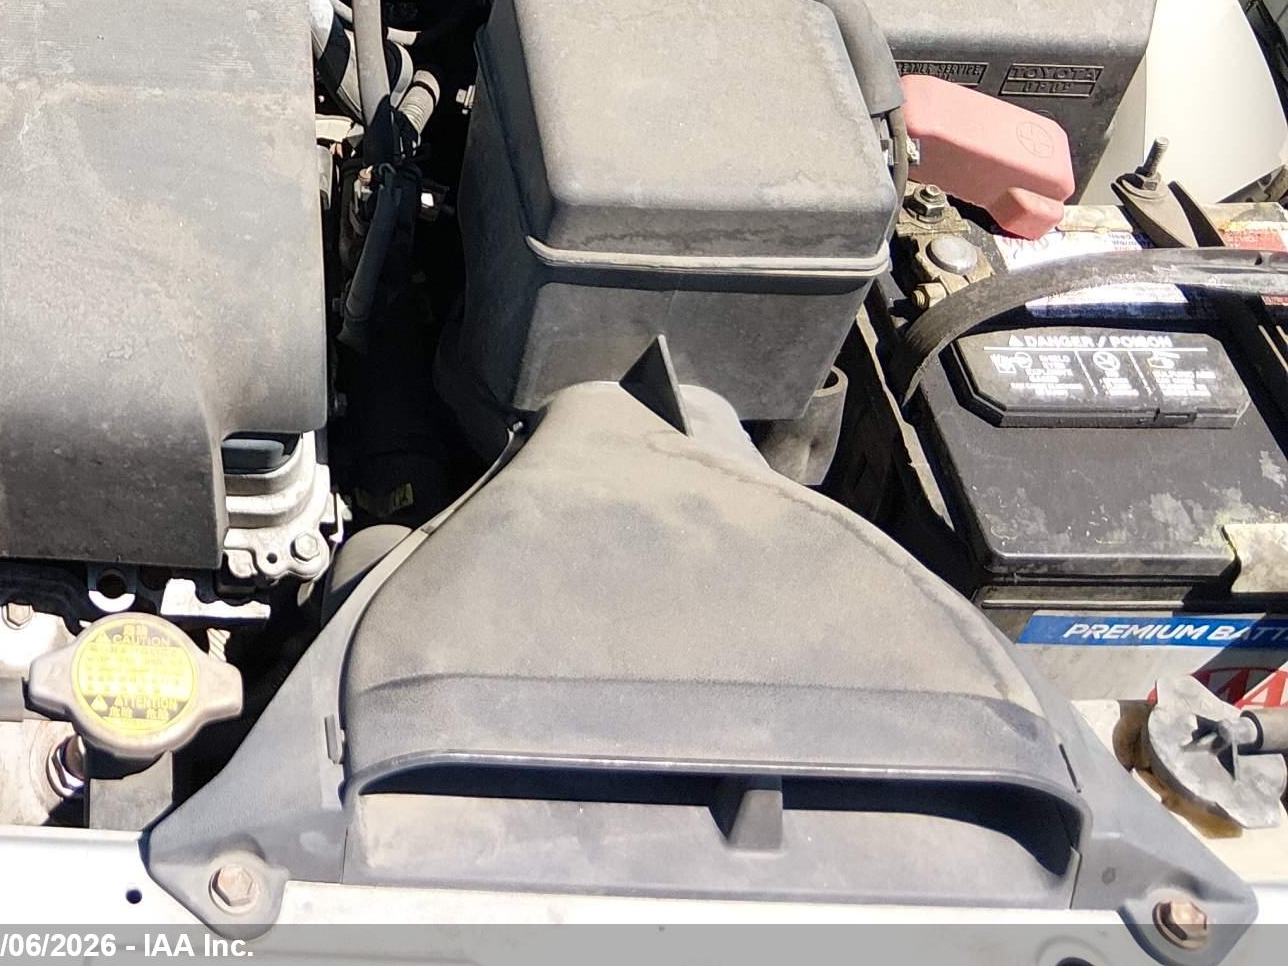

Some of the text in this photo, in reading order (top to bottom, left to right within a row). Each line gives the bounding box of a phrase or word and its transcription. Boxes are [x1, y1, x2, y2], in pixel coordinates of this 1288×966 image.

[1011, 66, 1096, 81] TOYOTA
[1025, 335, 1095, 347] DANGER
[1063, 624, 1288, 641] PREMIUM BATT
[112, 634, 171, 647] CAUTION
[113, 695, 178, 711] ATTENTION
